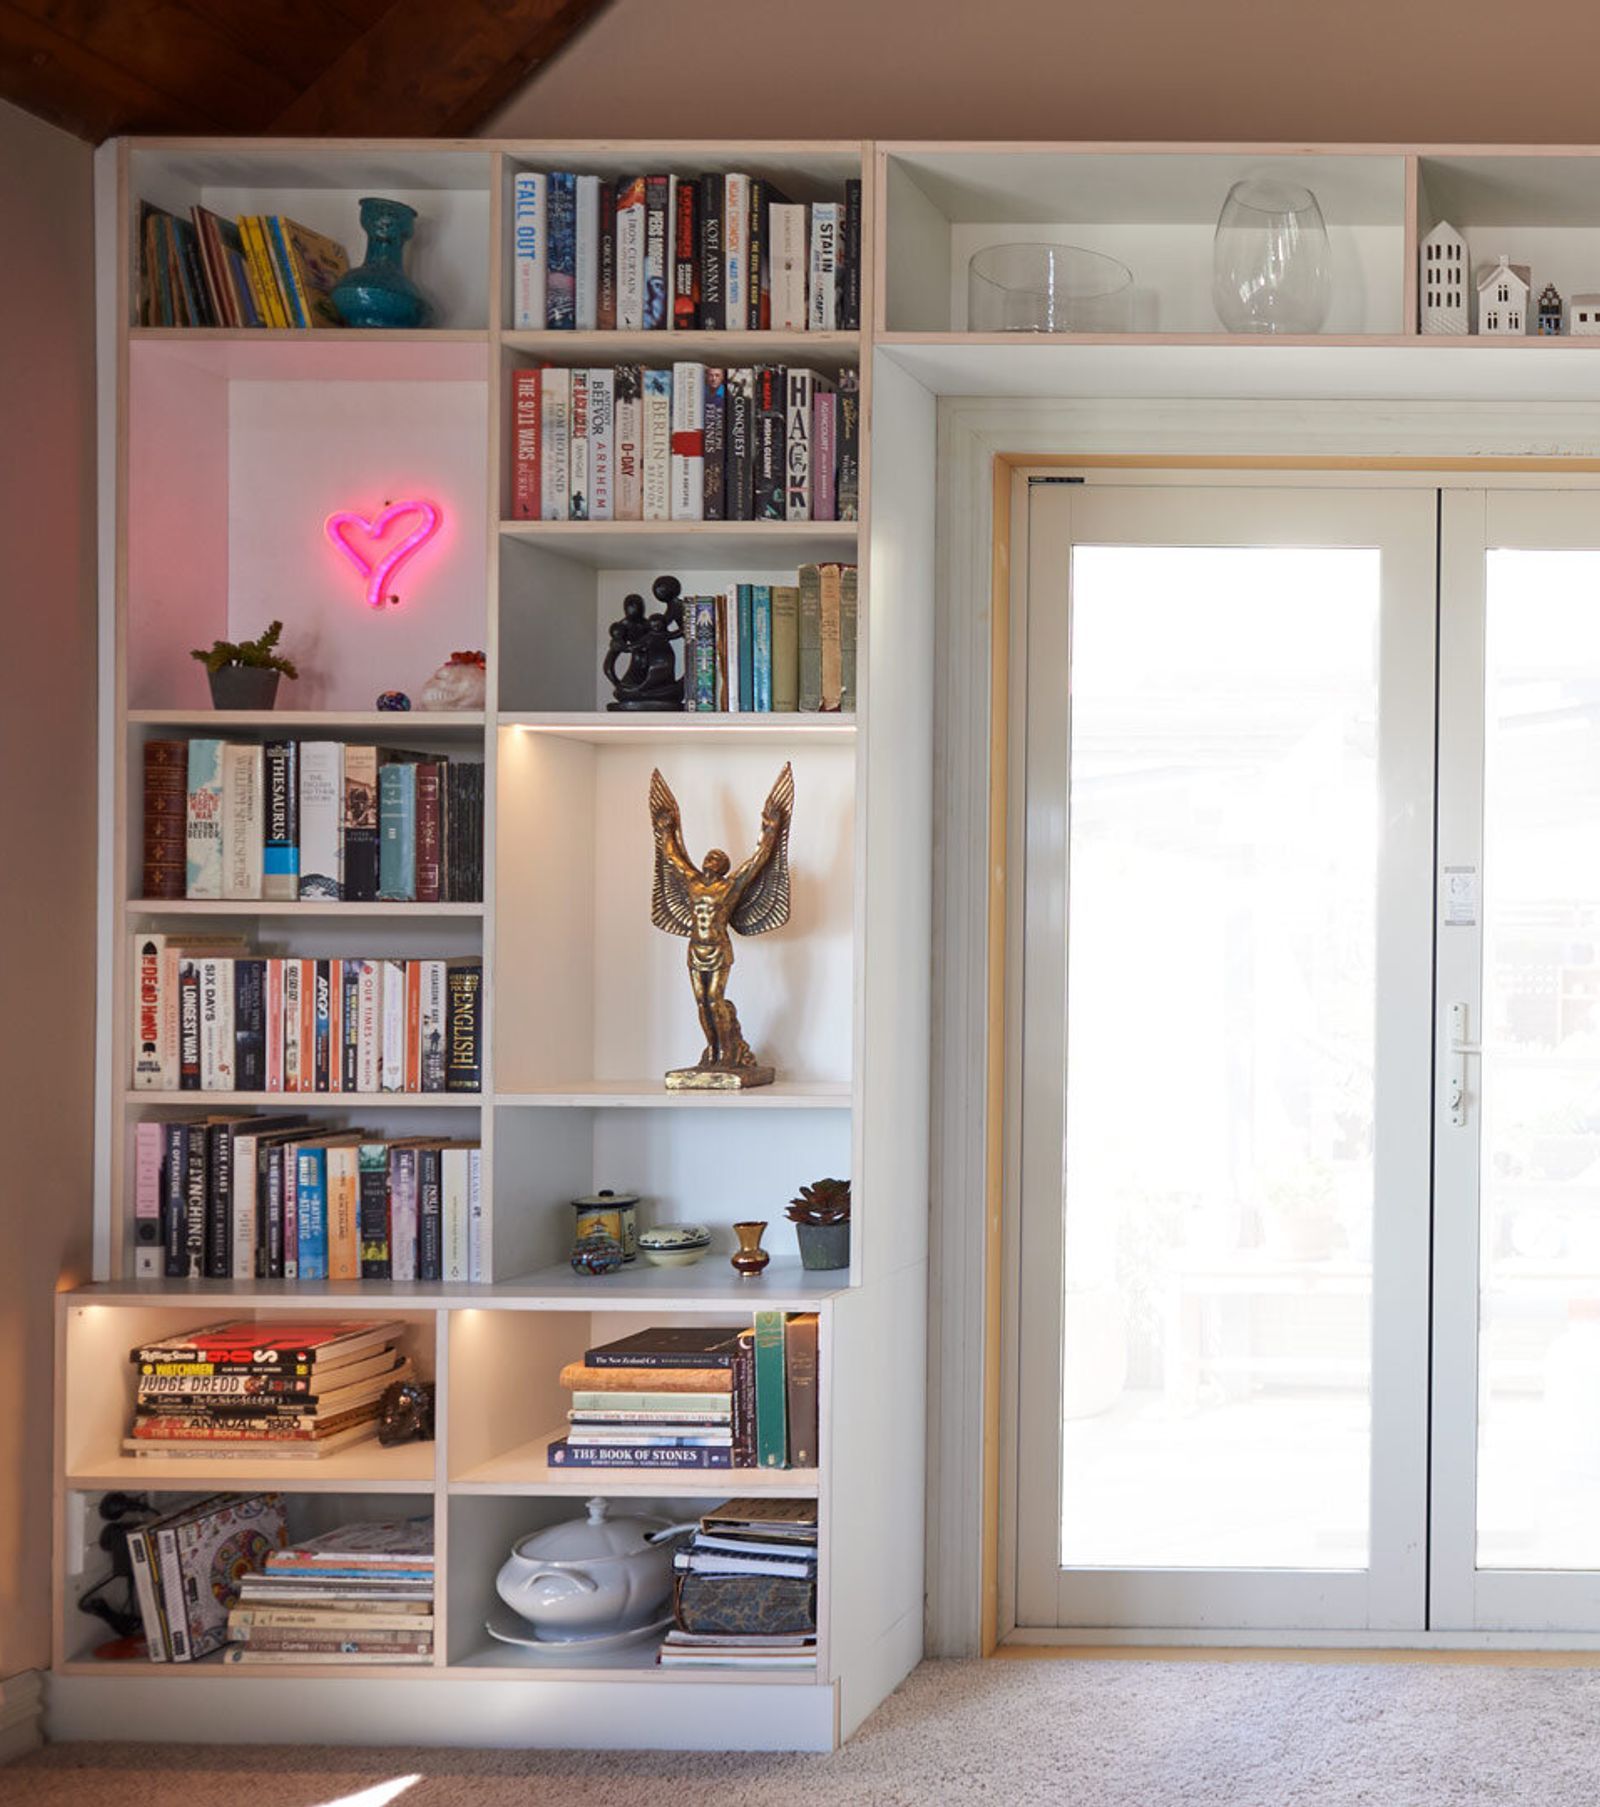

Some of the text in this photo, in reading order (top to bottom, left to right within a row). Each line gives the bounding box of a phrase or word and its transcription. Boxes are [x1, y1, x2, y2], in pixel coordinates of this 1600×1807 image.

[518, 181, 536, 219] FALL
[518, 226, 536, 260] OUT
[706, 219, 719, 303] KOFI ANNAN
[820, 223, 834, 272] STALIN
[517, 377, 535, 460] THE 9/11 WARS
[591, 380, 607, 509] BEEVOR ARNHEM
[651, 401, 668, 461] BERLIN
[704, 403, 715, 453] FIENNES
[732, 396, 745, 458] CONQUEST
[555, 402, 566, 493] TOM HOLLAND
[621, 443, 635, 477] D-DAY
[271, 757, 286, 841] THESAURUS
[205, 964, 216, 1021] SIX DAYS
[317, 976, 328, 1020] ARGO
[183, 985, 198, 1064] LONGEST WAR
[453, 992, 474, 1064] ENGLISH
[172, 1131, 181, 1145] THE
[219, 1133, 228, 1193] BLACK FLAGS
[171, 1148, 181, 1199] OPERATORS
[187, 1166, 203, 1247] LYNCHING
[140, 1377, 240, 1393] JUDGE DREDD
[156, 1363, 214, 1376] WATCHMEN
[190, 1419, 257, 1430] ANNUAL
[573, 1449, 697, 1461] THE BOOK OF STONES
